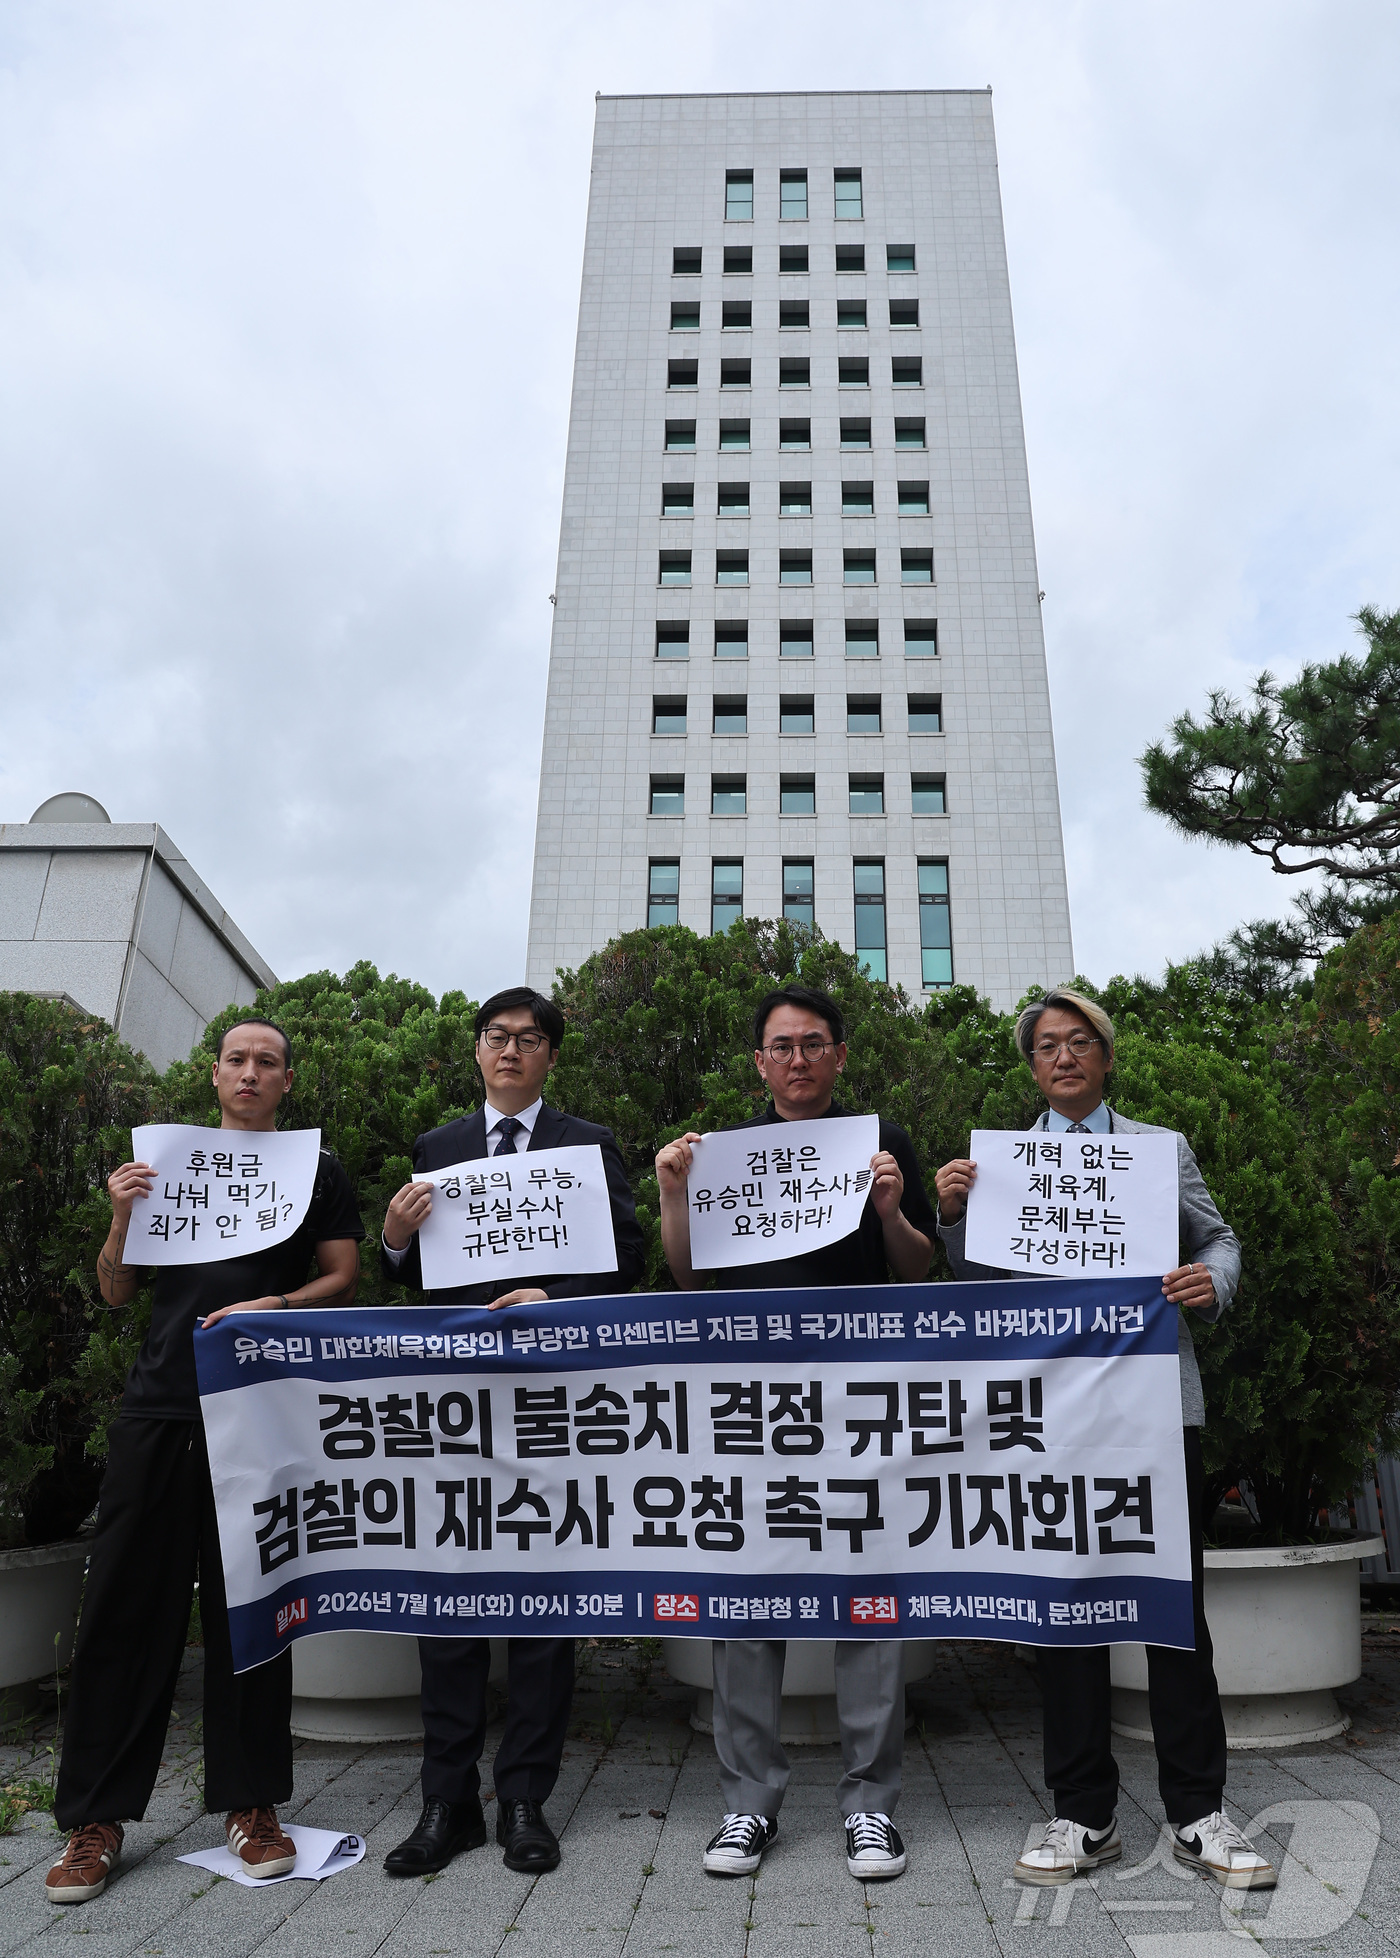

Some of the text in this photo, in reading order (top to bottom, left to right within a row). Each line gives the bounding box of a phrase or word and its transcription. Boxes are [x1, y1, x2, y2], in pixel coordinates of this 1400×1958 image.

[186, 1150, 263, 1178] 후원금
[746, 1146, 821, 1175] 검찰은
[1013, 1141, 1133, 1171] 개혁 없는
[164, 1180, 285, 1209] 나눠 먹기,
[439, 1168, 583, 1199] 경찰의 무능,
[692, 1168, 872, 1213] 유승민 재수사를
[1029, 1172, 1116, 1202] 체육계,
[148, 1203, 293, 1241] 죄가 안 됨?
[466, 1195, 565, 1226] 부실수사
[731, 1205, 833, 1239] 요청하라!
[1017, 1205, 1125, 1236] 문체부는
[462, 1226, 569, 1258] 규탄한다!
[1009, 1238, 1126, 1268] 각성하라!
[234, 1305, 1144, 1365] 유승민 대한체육회장의 부당한 인센티브 지급 및 국가대표 선수 바꿔치기 사건
[318, 1377, 1046, 1460] 경찰의 불송치 결정 규탄 및
[253, 1473, 1156, 1576] 검찰의 재수사 요청 촉구 기자회견
[276, 1592, 1139, 1633] 일시 2026년 7월 14일(화) 09시 30분 장소 대검찰청 앞 주최 체육시민연대, 문화연대
